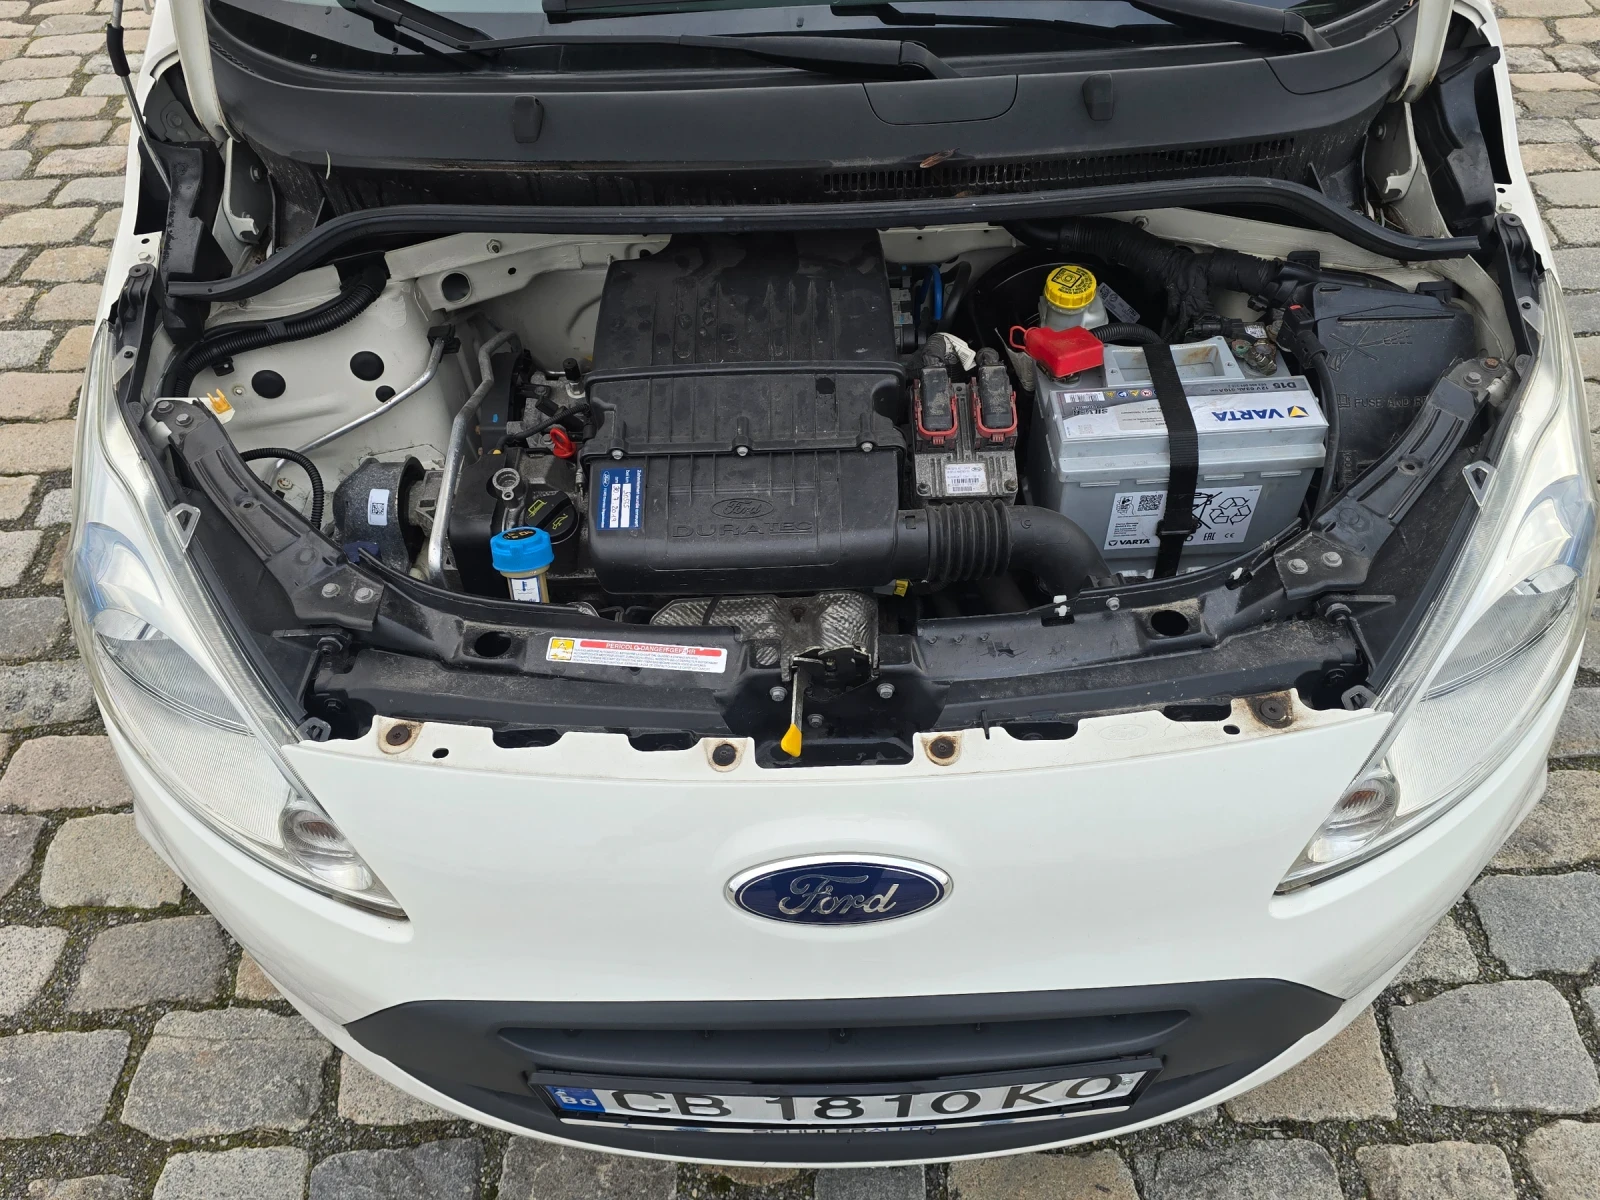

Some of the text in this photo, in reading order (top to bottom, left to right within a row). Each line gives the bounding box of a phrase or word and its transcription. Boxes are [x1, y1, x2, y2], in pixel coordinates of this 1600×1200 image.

[1354, 398, 1382, 408] FUSE
[1387, 397, 1409, 408] AND
[1073, 408, 1109, 416] SILVER
[1211, 408, 1285, 422] VARTA
[722, 501, 762, 515] Ford
[672, 521, 813, 538] DURATEC
[778, 874, 900, 915] Ford
[560, 1095, 598, 1107] BG
[611, 1074, 1123, 1121] CB 1810 KO
